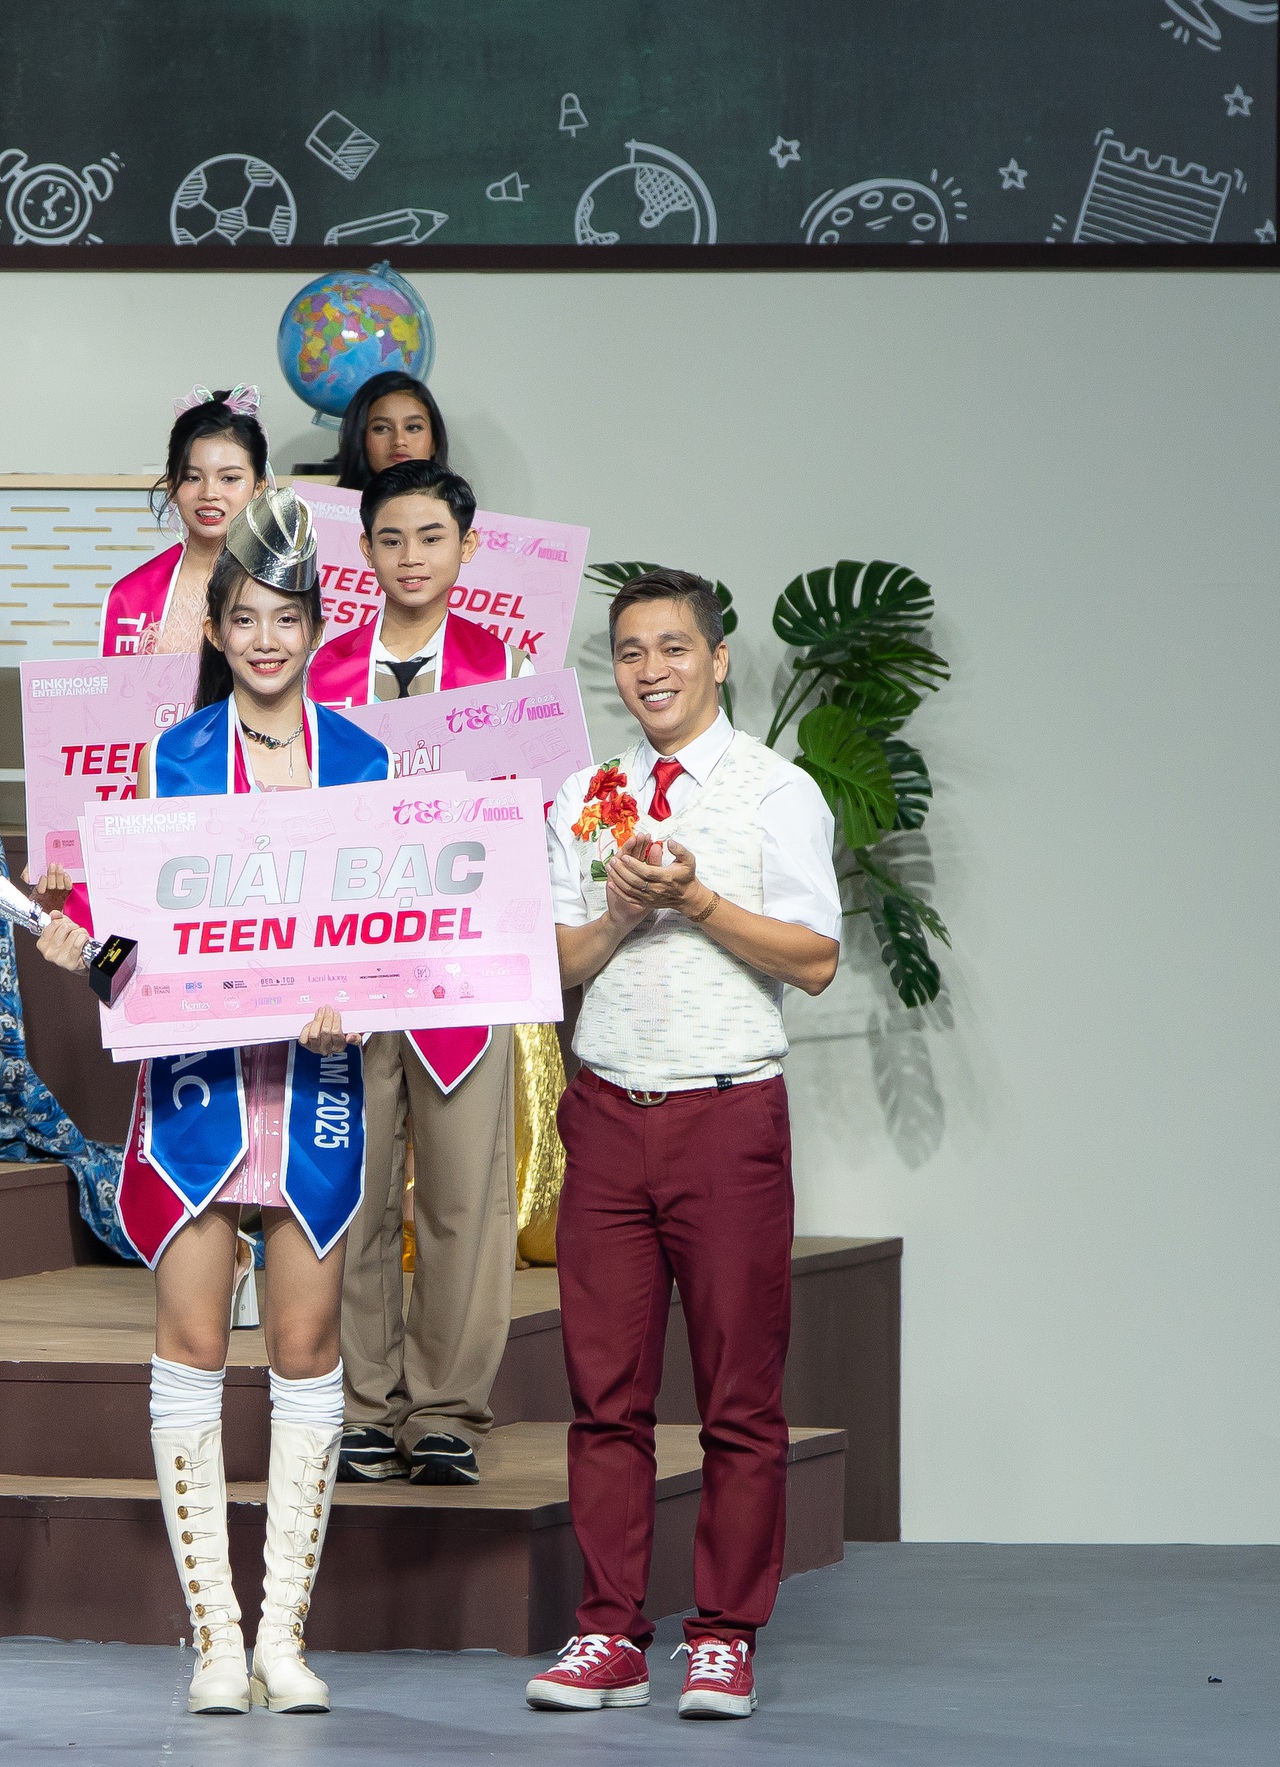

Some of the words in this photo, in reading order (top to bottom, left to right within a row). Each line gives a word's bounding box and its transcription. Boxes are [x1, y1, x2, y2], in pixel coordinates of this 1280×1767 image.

[445, 585, 527, 620] ODEL
[32, 676, 109, 690] PINKHOUSE
[32, 686, 109, 698] ENTERTAINMENT
[526, 702, 564, 722] MODEL
[103, 811, 198, 827] PINKHOUSE
[482, 806, 524, 822] MODEL
[104, 822, 198, 836] ENTERTAINMENT
[155, 835, 308, 910] GIẢI
[331, 841, 487, 909] BẠC
[172, 917, 297, 956] TEEN
[313, 907, 483, 950] MODEL
[314, 1091, 350, 1150] 2025
